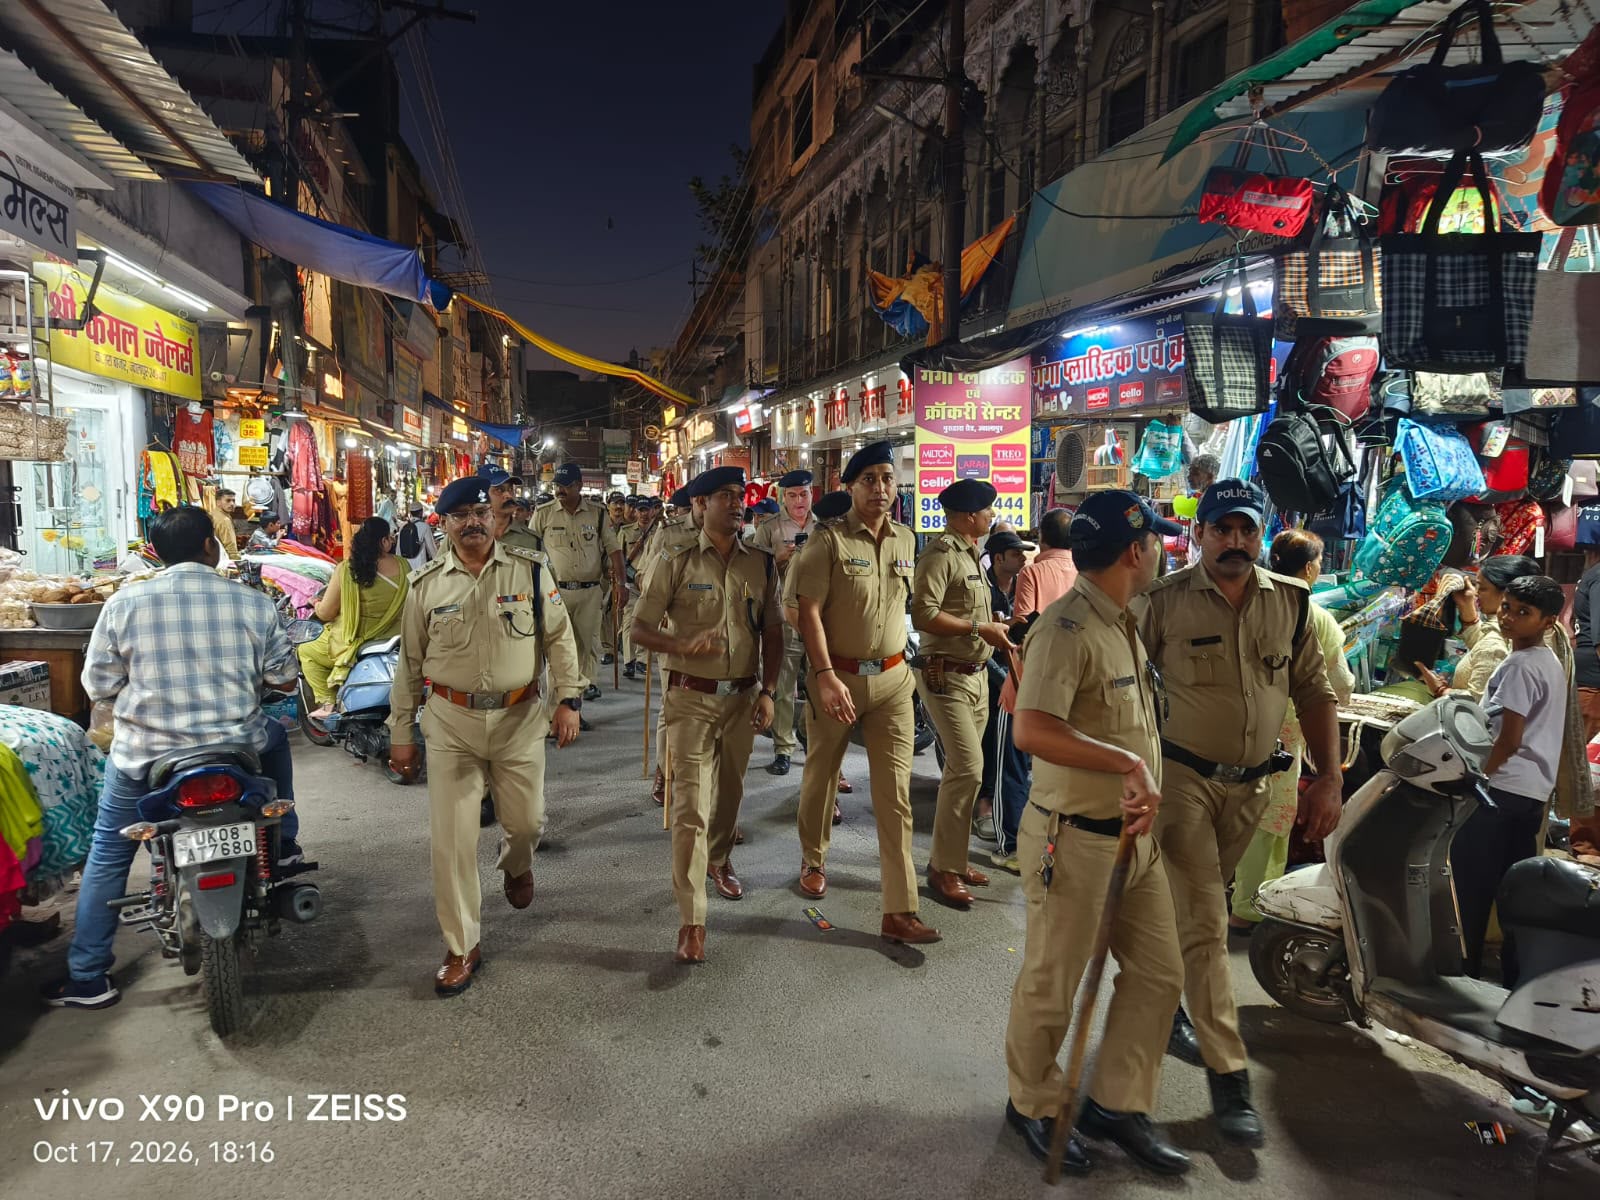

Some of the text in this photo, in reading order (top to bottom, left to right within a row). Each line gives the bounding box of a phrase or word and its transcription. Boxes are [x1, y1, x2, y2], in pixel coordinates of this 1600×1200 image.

[86, 312, 139, 358] कमल
[1032, 356, 1062, 390] गंगा
[1062, 345, 1134, 385] प्लास्टिक
[1136, 329, 1167, 373] एवं
[1120, 388, 1142, 398] cello
[921, 447, 953, 459] MILTON
[995, 449, 1022, 459] TREO
[958, 460, 989, 470] LARAH
[921, 476, 952, 488] cello
[1216, 488, 1252, 500] POLICE
[195, 827, 240, 846] UK08
[187, 839, 253, 864] AT7680
